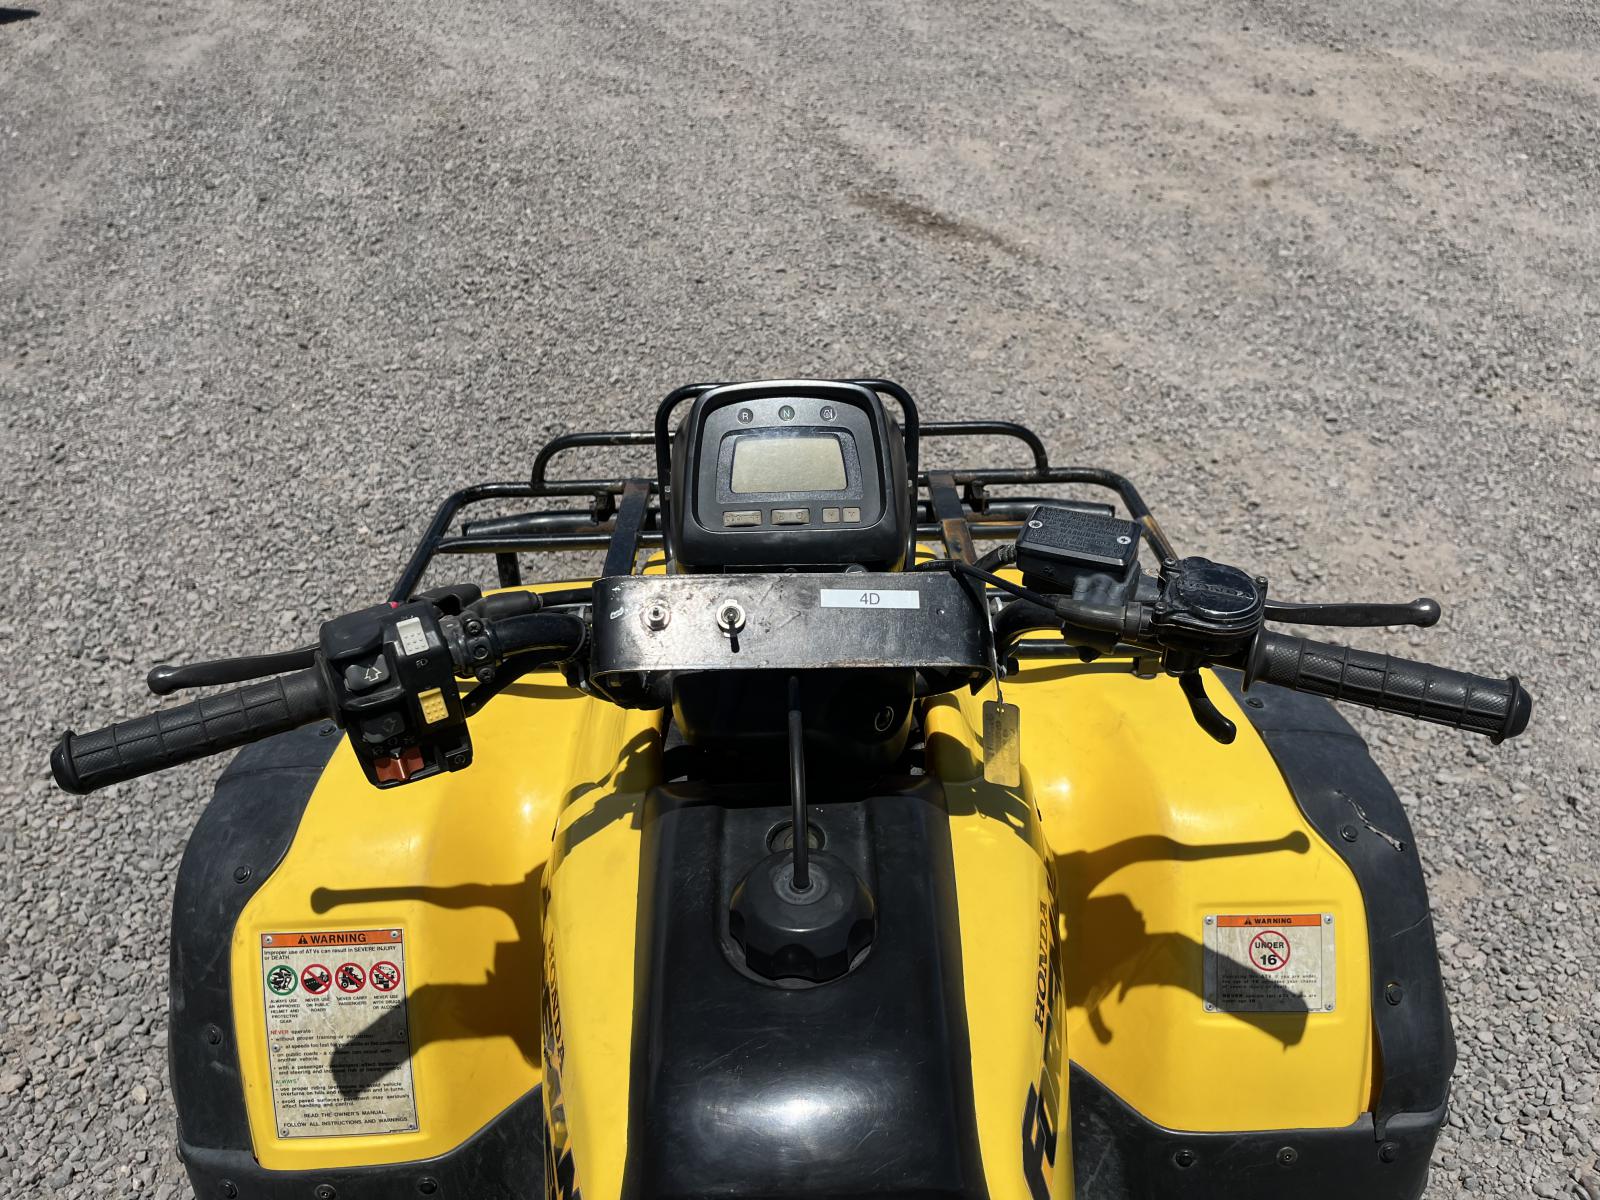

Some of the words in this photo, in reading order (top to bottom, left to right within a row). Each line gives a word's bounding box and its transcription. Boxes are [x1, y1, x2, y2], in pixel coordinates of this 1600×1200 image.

[860, 592, 880, 604] 4D
[310, 934, 366, 944] WARNING
[1260, 954, 1277, 965] 16
[1035, 900, 1048, 1032] HONDA
